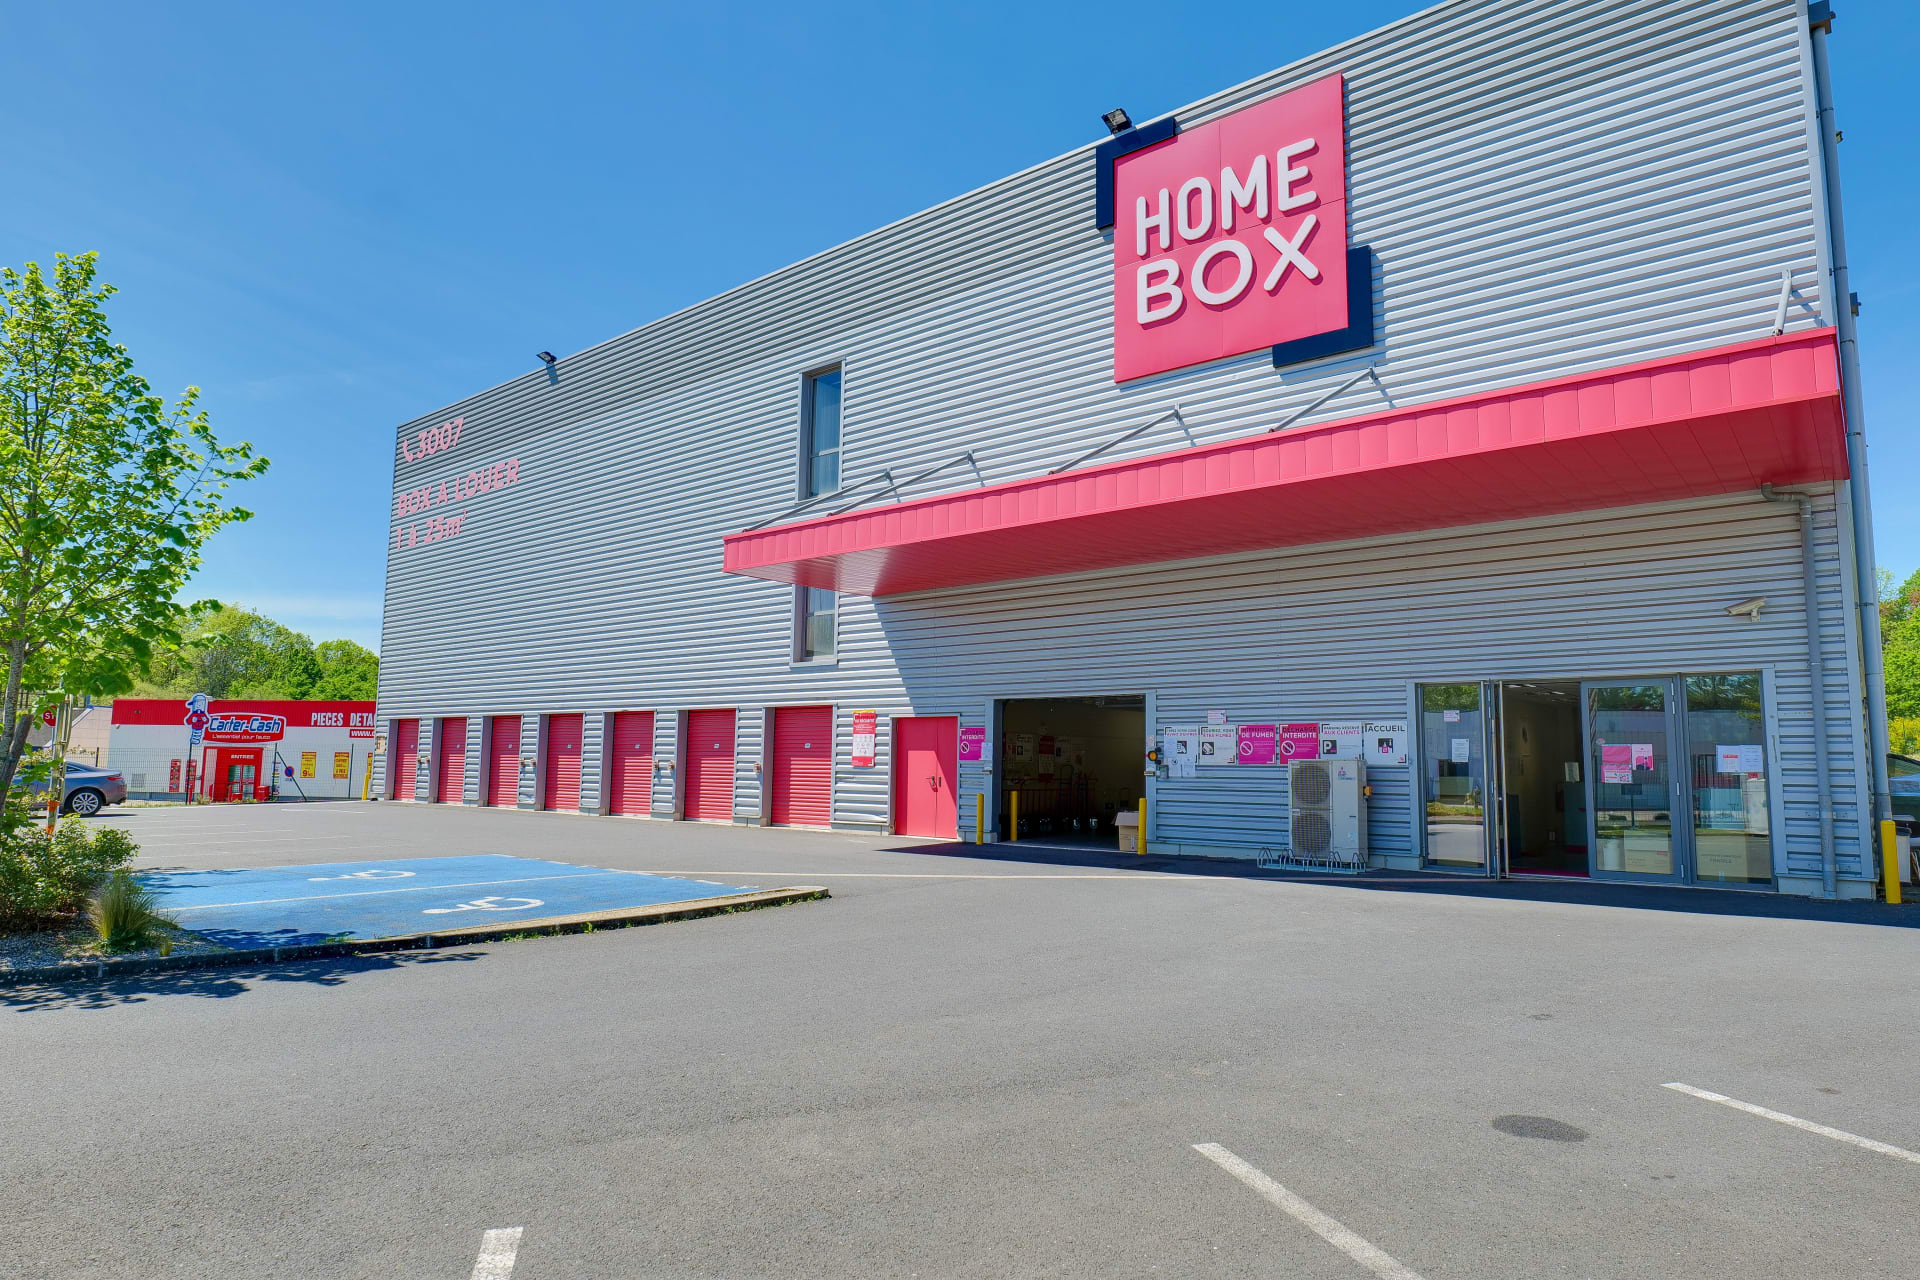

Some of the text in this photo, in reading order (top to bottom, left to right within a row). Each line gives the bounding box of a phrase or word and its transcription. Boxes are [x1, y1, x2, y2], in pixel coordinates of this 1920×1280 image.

[1136, 138, 1317, 257] HOME
[1137, 214, 1320, 324] BOX
[416, 417, 464, 459] 3007
[397, 459, 520, 517] BOX A LOUER
[397, 528, 402, 550] 1
[209, 716, 282, 732] Carter-Cash
[311, 712, 376, 726] PIECES DETA
